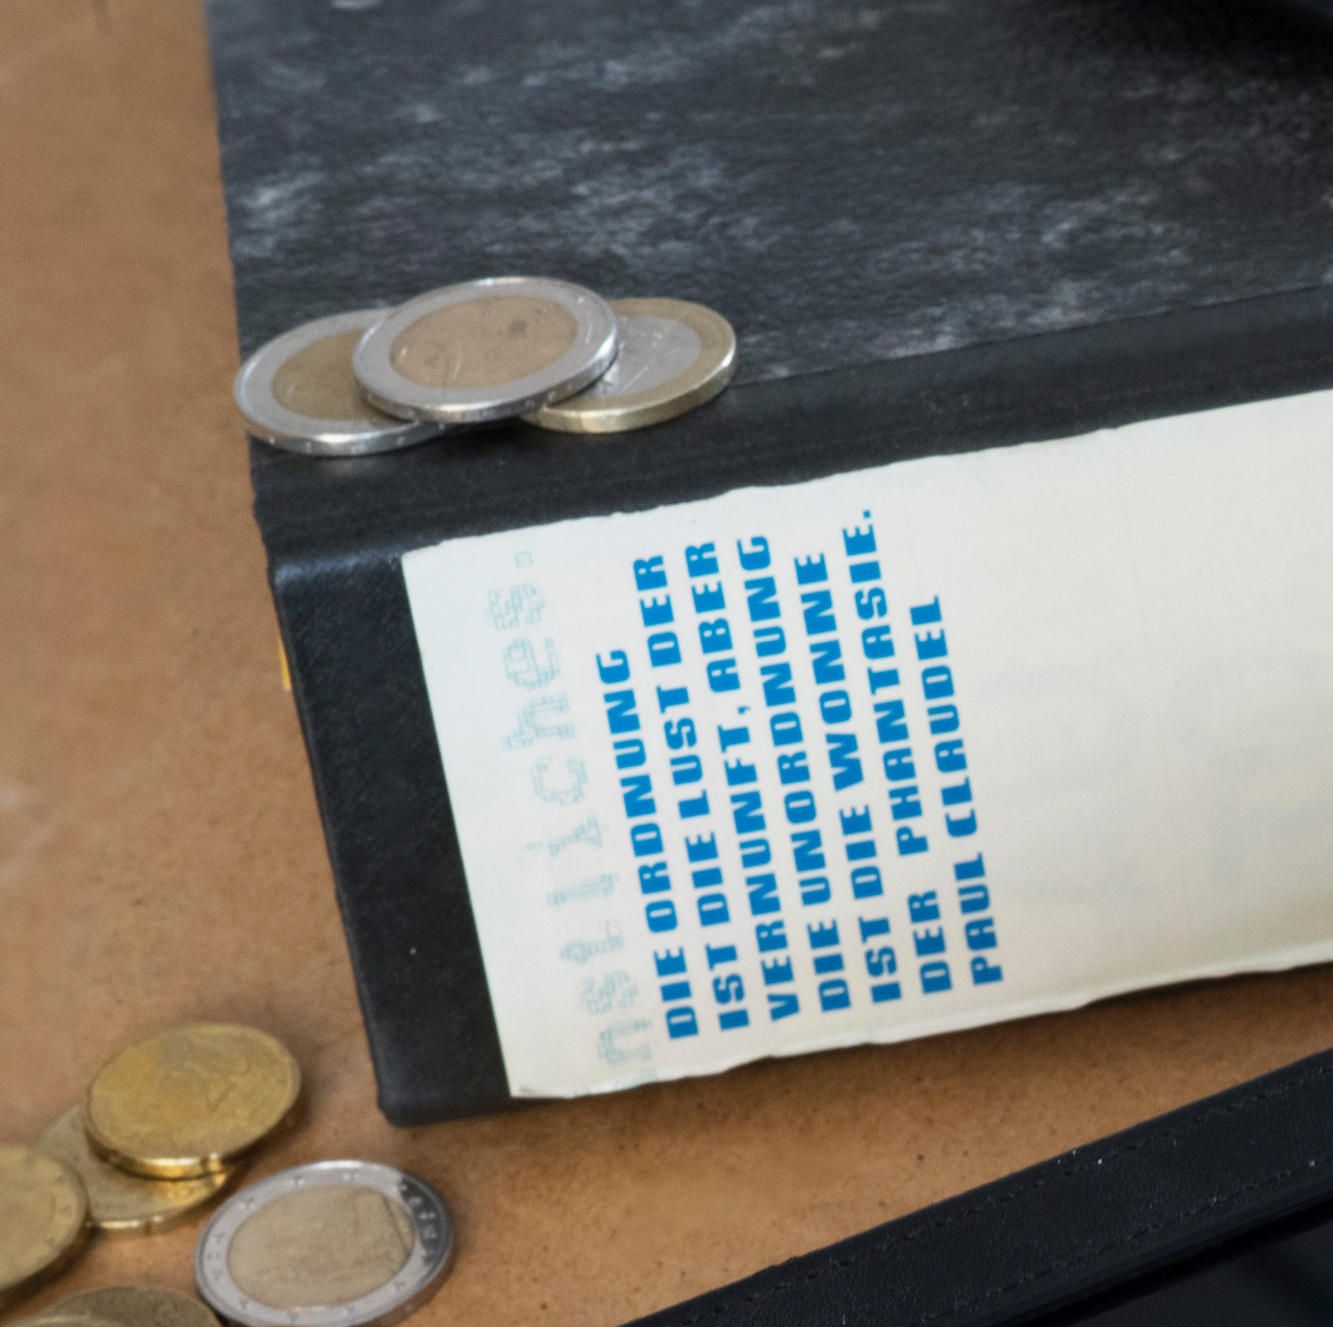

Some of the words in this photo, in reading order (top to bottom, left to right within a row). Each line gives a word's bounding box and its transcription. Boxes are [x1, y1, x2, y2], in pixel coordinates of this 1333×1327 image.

[633, 555, 682, 668] DER
[684, 541, 741, 694] ABER
[793, 551, 865, 791] WONNE
[737, 535, 832, 906] UNORDNUNG
[842, 509, 929, 857] PHANTASIE.
[909, 596, 978, 838] CLAUDEL
[595, 649, 679, 934] ORDNUNG
[656, 684, 711, 819] LUST
[685, 832, 731, 926] DIE
[717, 704, 800, 1021] VERNUNFT,
[839, 803, 885, 900] DIE
[953, 851, 1004, 986] PAUL
[652, 945, 700, 1040] DIE
[704, 943, 749, 1031] IST
[807, 918, 852, 1013] DIE
[857, 915, 902, 1004] IST
[907, 889, 953, 995] DER
